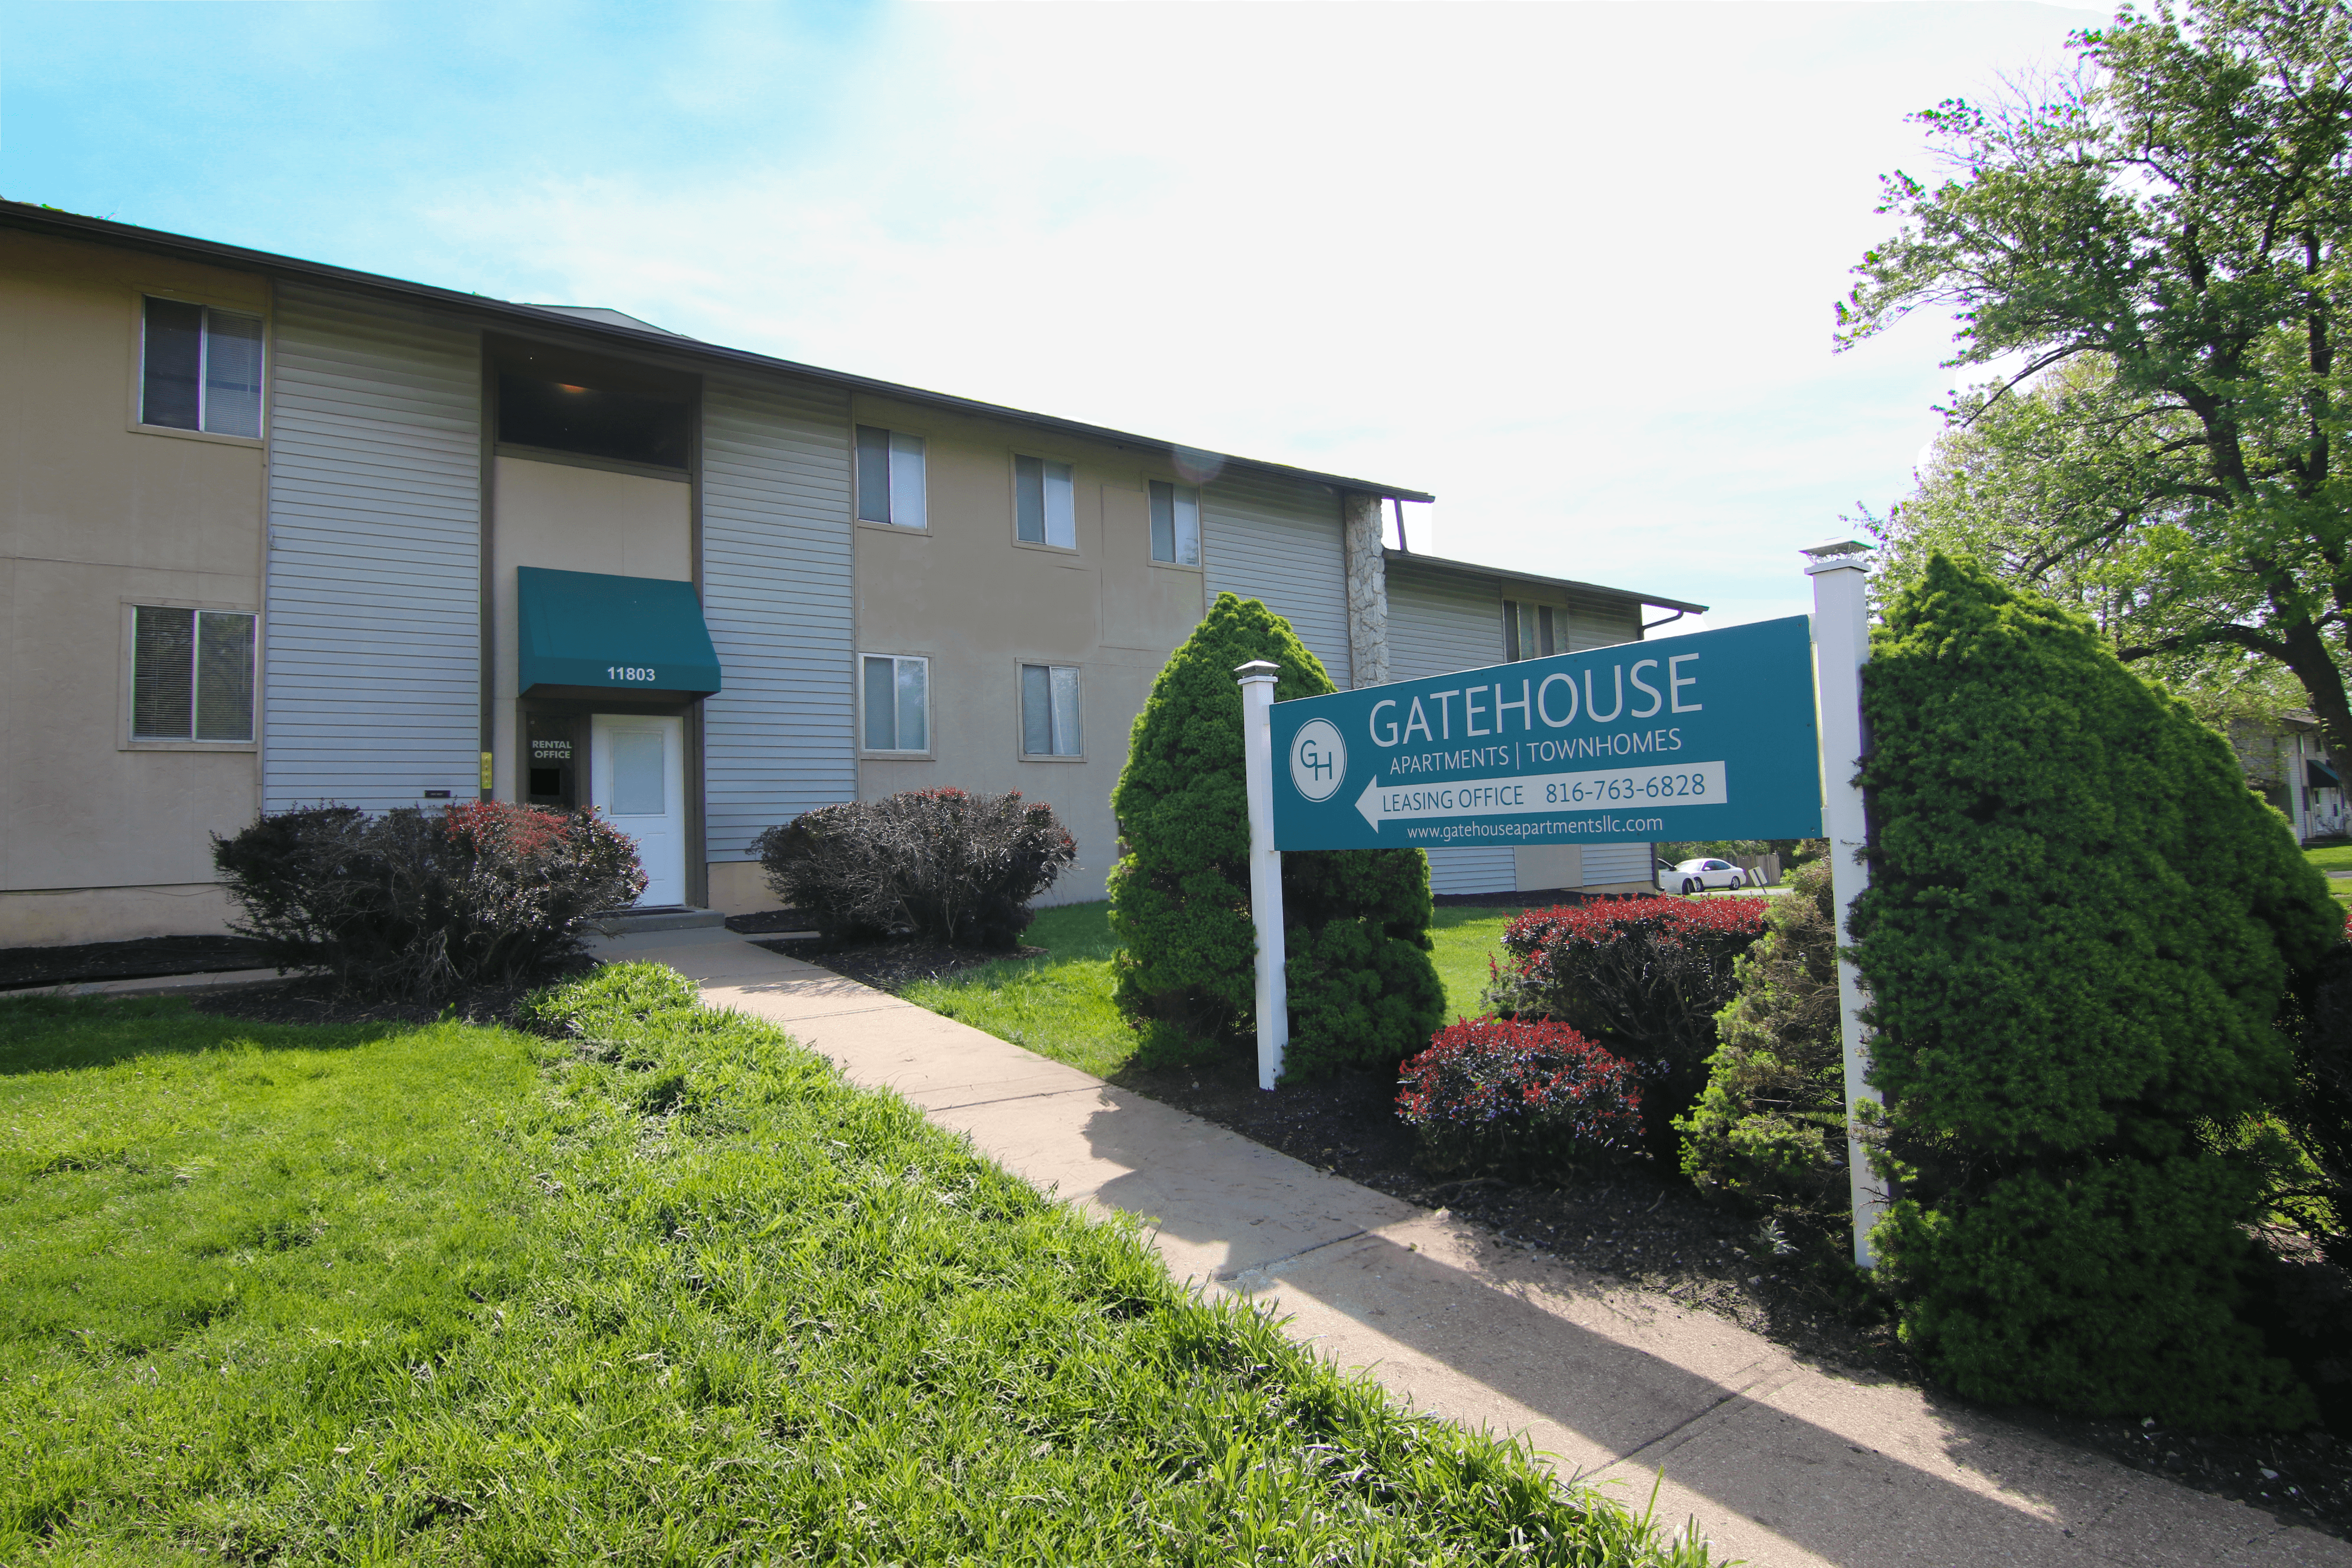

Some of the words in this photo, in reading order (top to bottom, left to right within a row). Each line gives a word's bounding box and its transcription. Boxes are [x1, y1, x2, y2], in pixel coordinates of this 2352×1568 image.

[607, 667, 656, 681] 11803
[1369, 652, 1703, 747] GATEHOUSE
[532, 740, 572, 749] RENTAL
[534, 750, 570, 759] OFFICE
[1300, 739, 1333, 782] GH
[1390, 745, 1509, 775] APARTMENTS
[1526, 727, 1682, 763] TOWNHOMES
[1383, 790, 1453, 812] LEASING
[1459, 785, 1524, 808] OFFICE
[1546, 773, 1705, 803] 816-763-6828
[1407, 815, 1663, 842] www.gatehouseapartmentsllc.com
